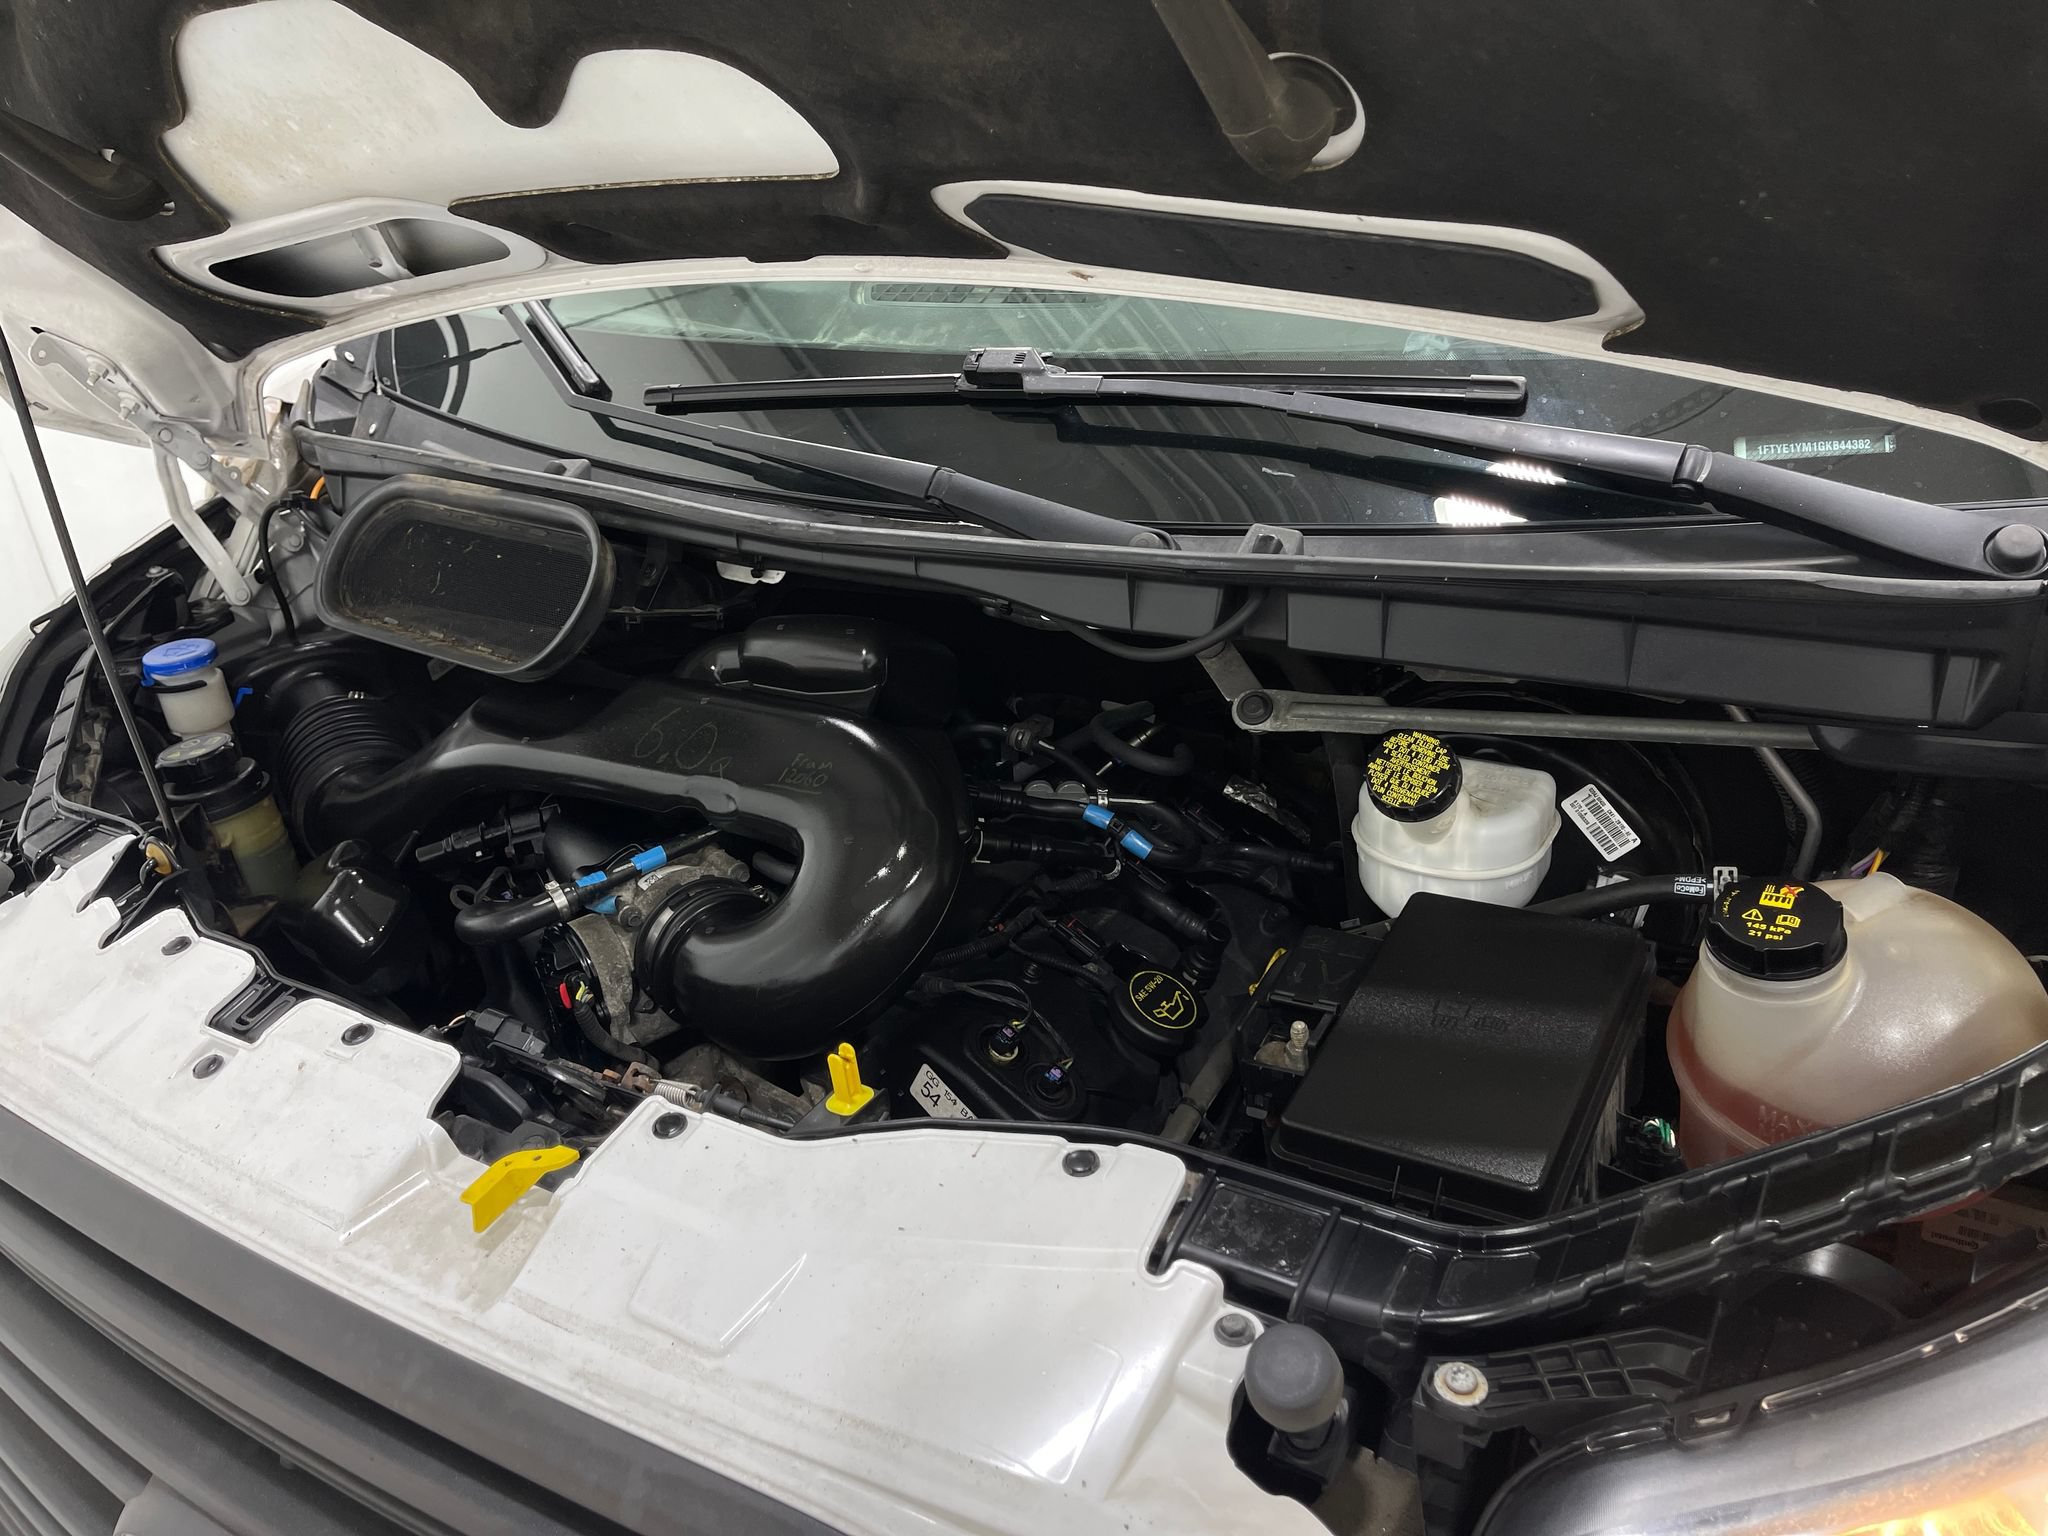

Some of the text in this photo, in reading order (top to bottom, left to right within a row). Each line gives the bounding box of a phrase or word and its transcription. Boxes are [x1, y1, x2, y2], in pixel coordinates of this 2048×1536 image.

[1757, 439, 1871, 455] 1FTYE1YM1GKB44382
[1389, 736, 1409, 748] BEFORE
[1439, 754, 1450, 763] USE
[1398, 733, 1415, 743] CLEAN
[1416, 739, 1434, 750] FILLER
[1383, 741, 1397, 749] ONLY
[1399, 747, 1409, 755] DOT
[1418, 754, 1433, 763] FLUID
[1434, 760, 1450, 770] FROM
[1391, 750, 1410, 762] SEALED
[1371, 777, 1382, 785] DOT
[1676, 884, 1704, 894] FoMoCo
[1746, 921, 1792, 935] 145 kPa
[1748, 929, 1784, 941] 21 psi
[1135, 974, 1164, 1002] SAE 5W-20
[920, 1080, 941, 1108] 54
